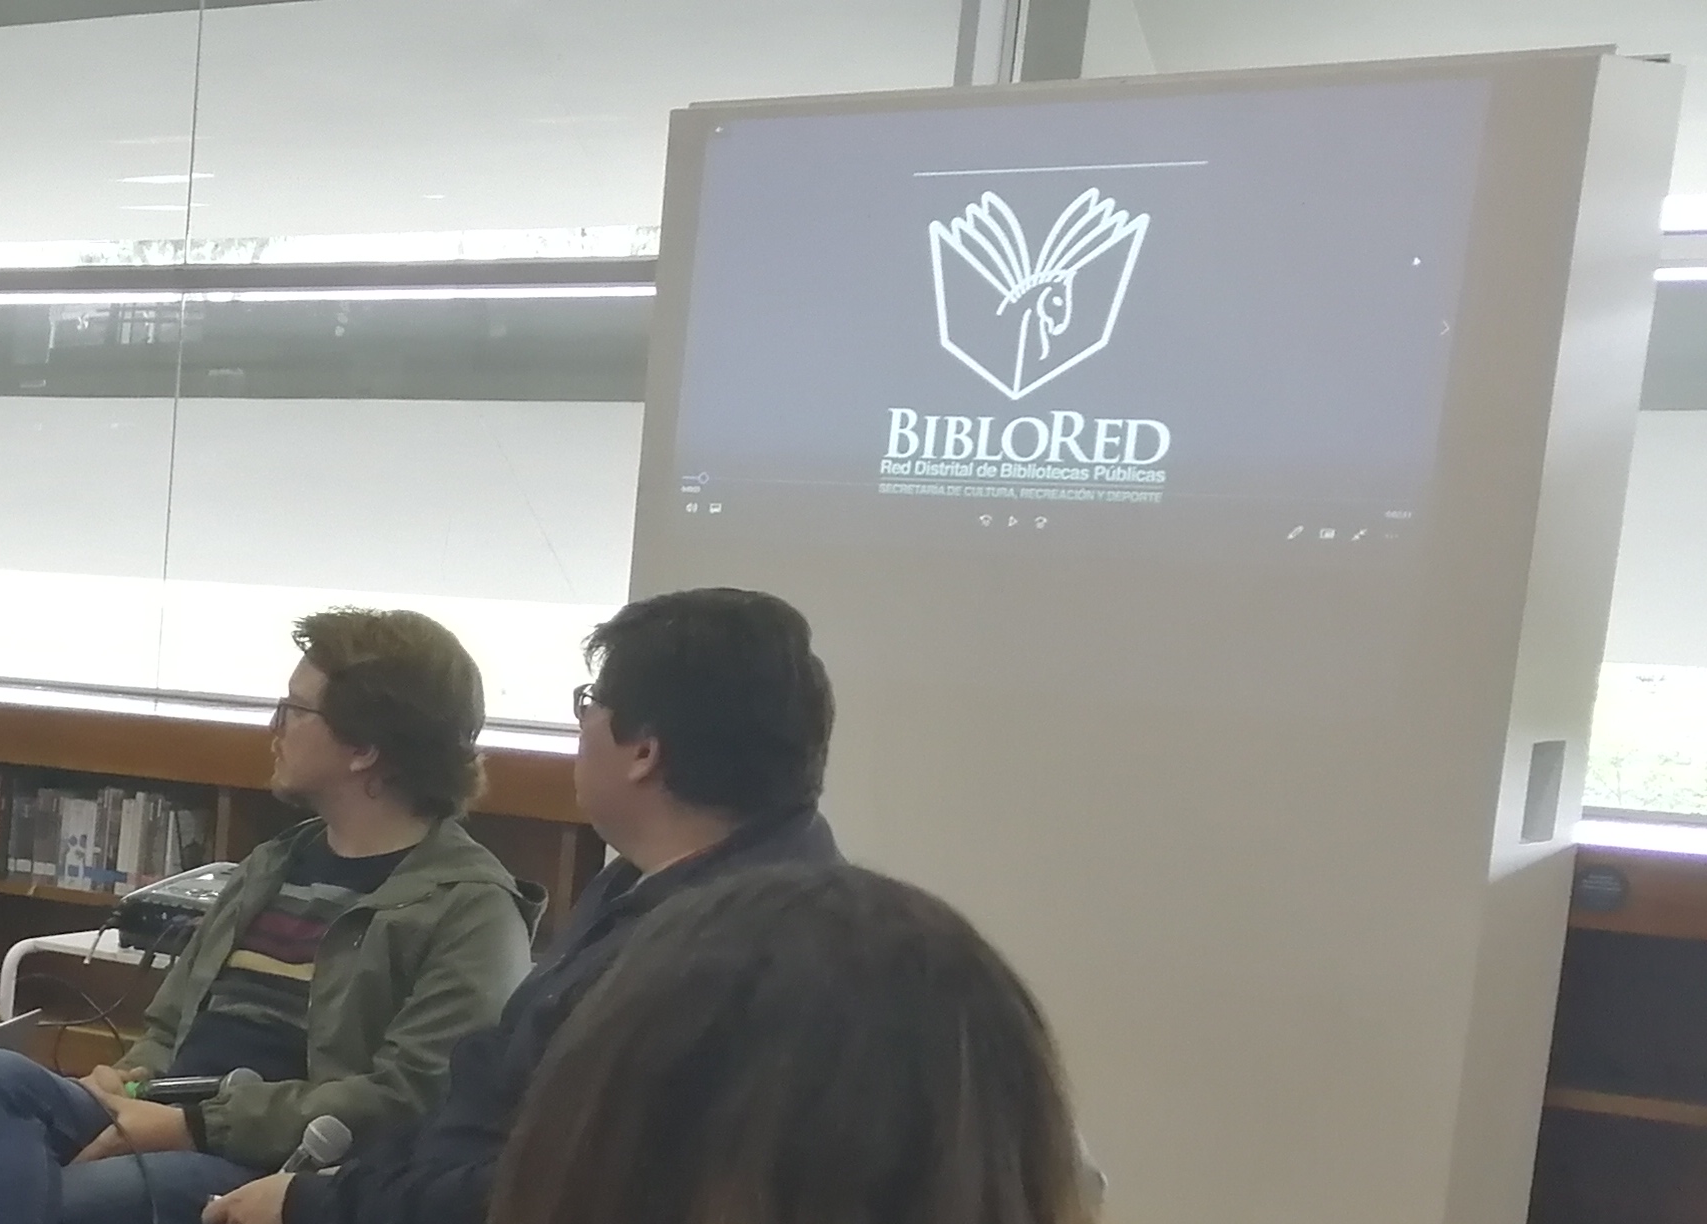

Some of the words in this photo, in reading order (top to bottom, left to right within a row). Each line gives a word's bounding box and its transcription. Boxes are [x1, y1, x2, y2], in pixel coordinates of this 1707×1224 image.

[880, 459, 911, 475] Red
[915, 460, 974, 476] Distrital
[976, 462, 998, 478] de
[1000, 462, 1090, 481] Bibliotecas
[1094, 465, 1166, 483] Públicas
